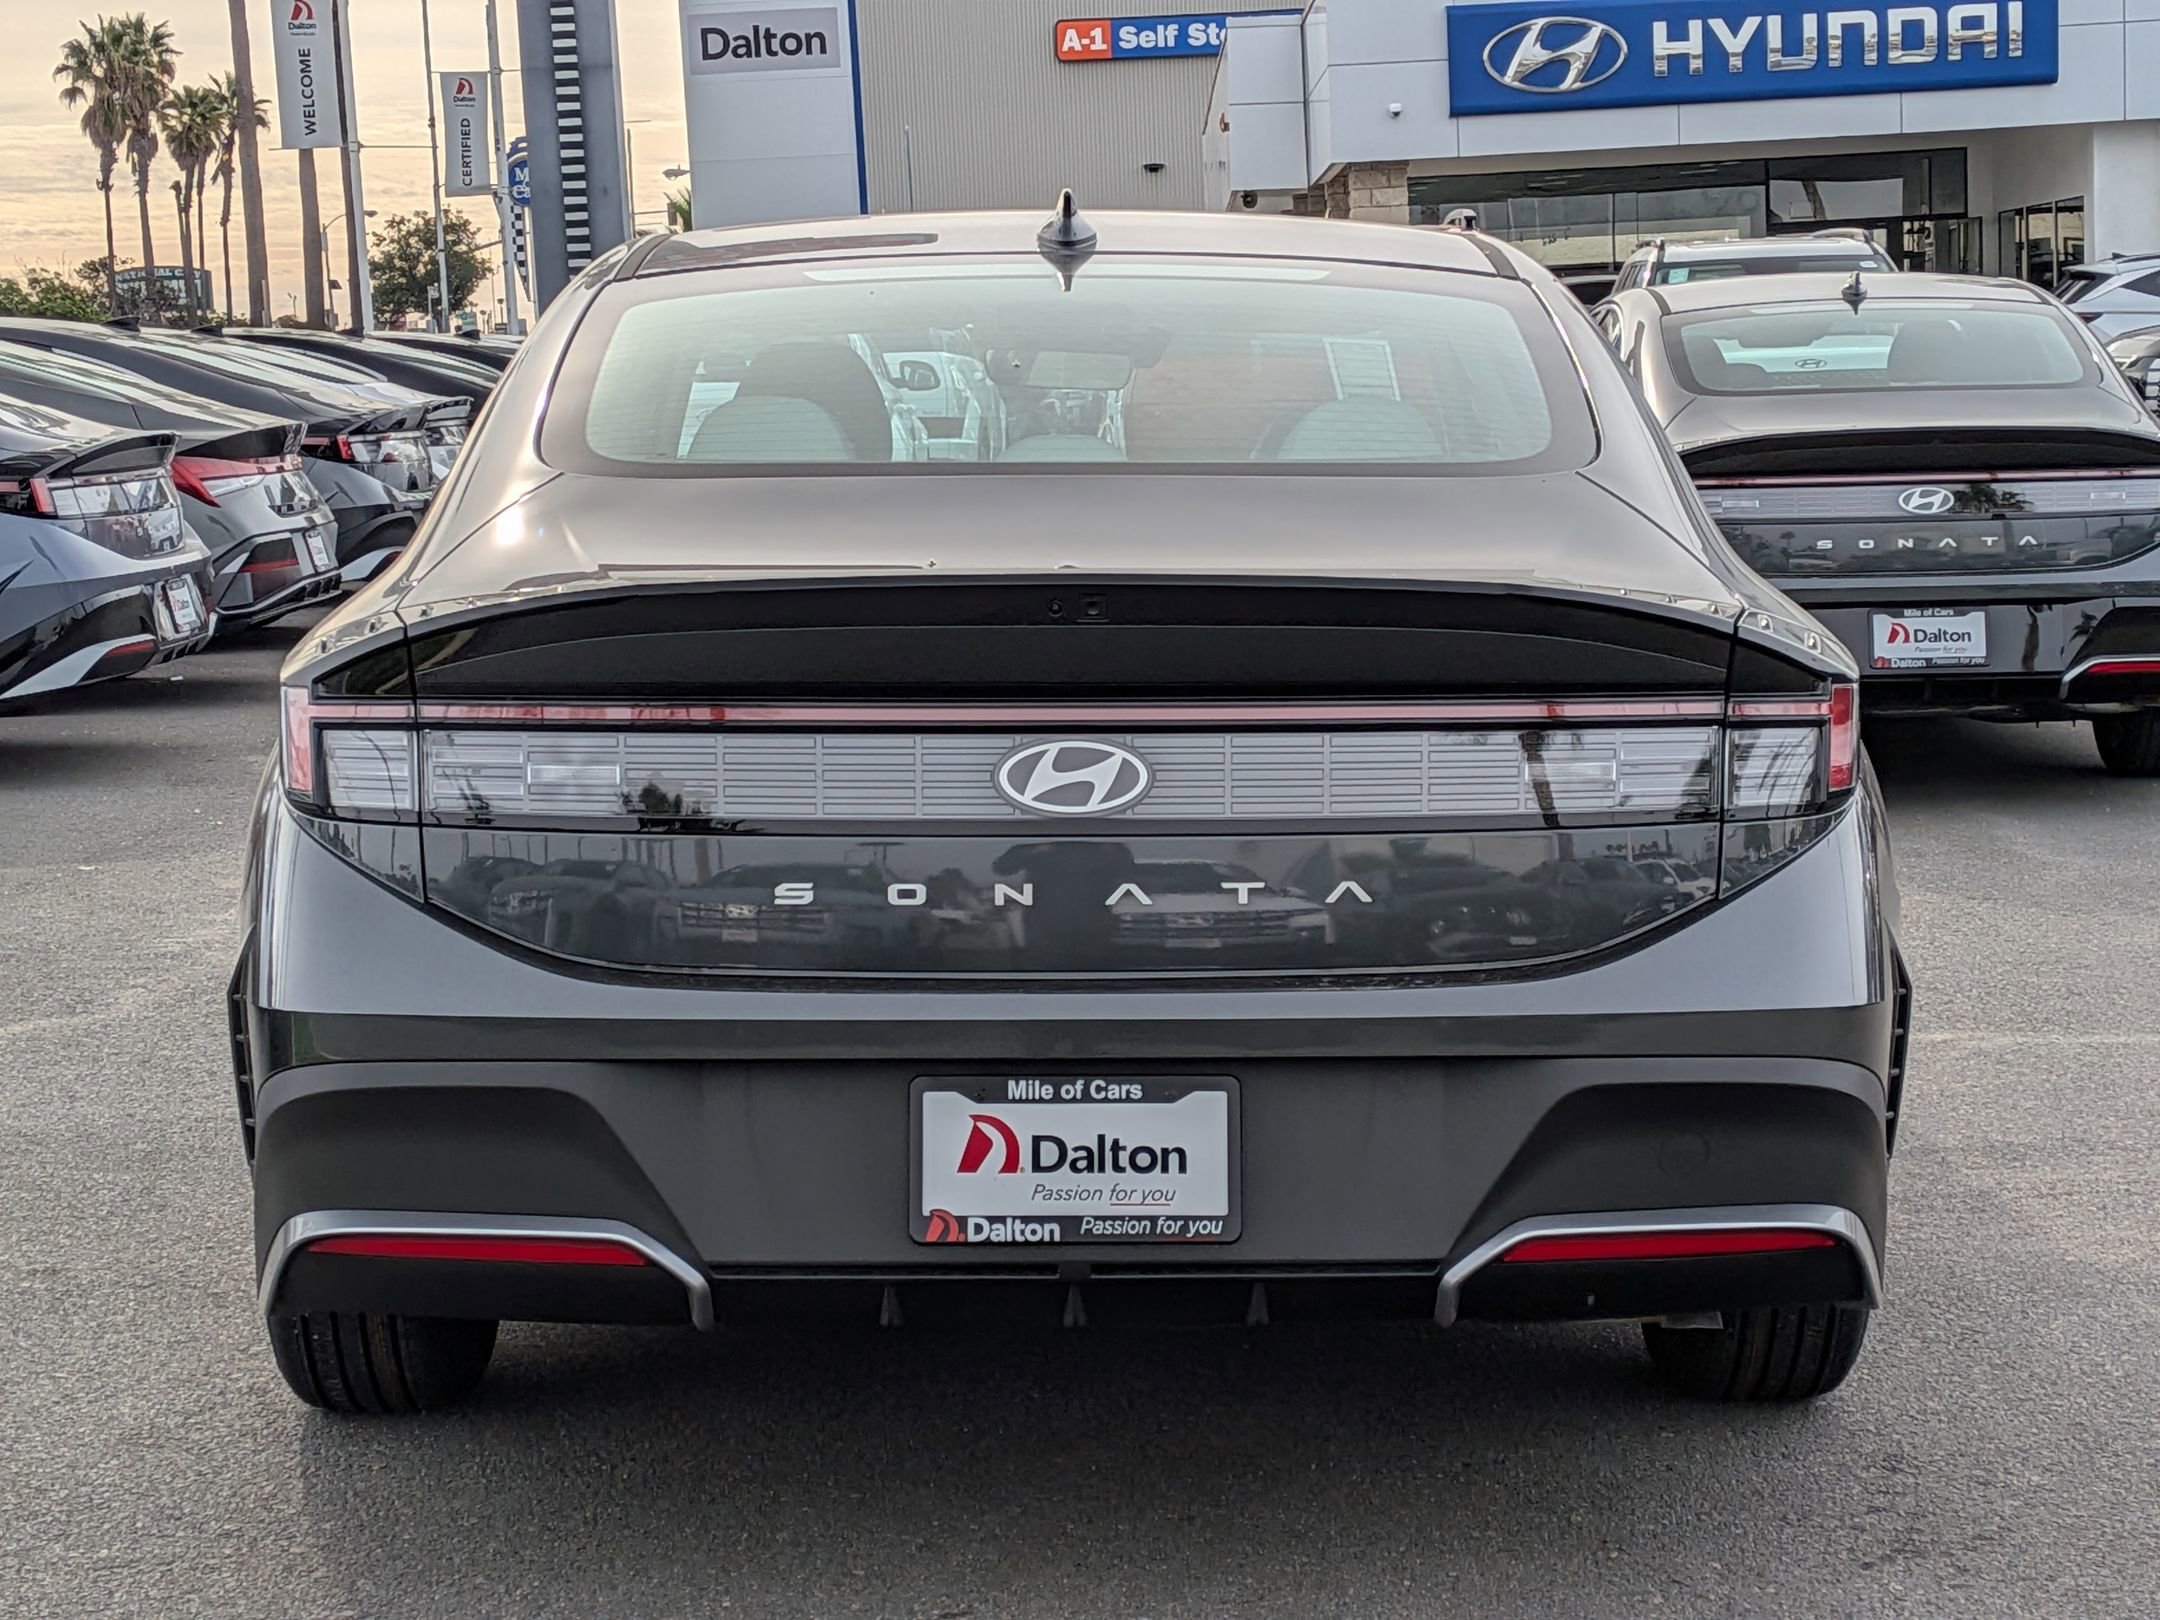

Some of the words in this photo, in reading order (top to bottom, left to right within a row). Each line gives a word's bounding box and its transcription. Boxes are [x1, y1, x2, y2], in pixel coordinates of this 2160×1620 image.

[700, 25, 827, 61] Dalton
[1061, 27, 1107, 52] A-1
[1118, 24, 1179, 49] Self
[1187, 22, 1227, 47] St
[1652, 1, 2023, 77] HYUNDAI
[298, 48, 317, 136] WELCOME
[460, 118, 473, 187] CERTIFIED
[1815, 535, 2038, 549] SONATA
[1913, 628, 1972, 643] Dalton
[1891, 658, 1926, 668] Dalton
[773, 880, 1374, 907] SONATA
[1007, 1080, 1054, 1100] Mile
[1061, 1079, 1084, 1100] of
[1090, 1080, 1143, 1100] Cars
[1031, 1134, 1187, 1174] Dalton
[1031, 1184, 1103, 1202] Passion
[1109, 1183, 1136, 1203] for
[1142, 1188, 1176, 1206] you
[967, 1217, 1061, 1242] Dalton
[1080, 1216, 1151, 1236] Passion
[1156, 1216, 1182, 1237] for
[1185, 1220, 1223, 1238] you
